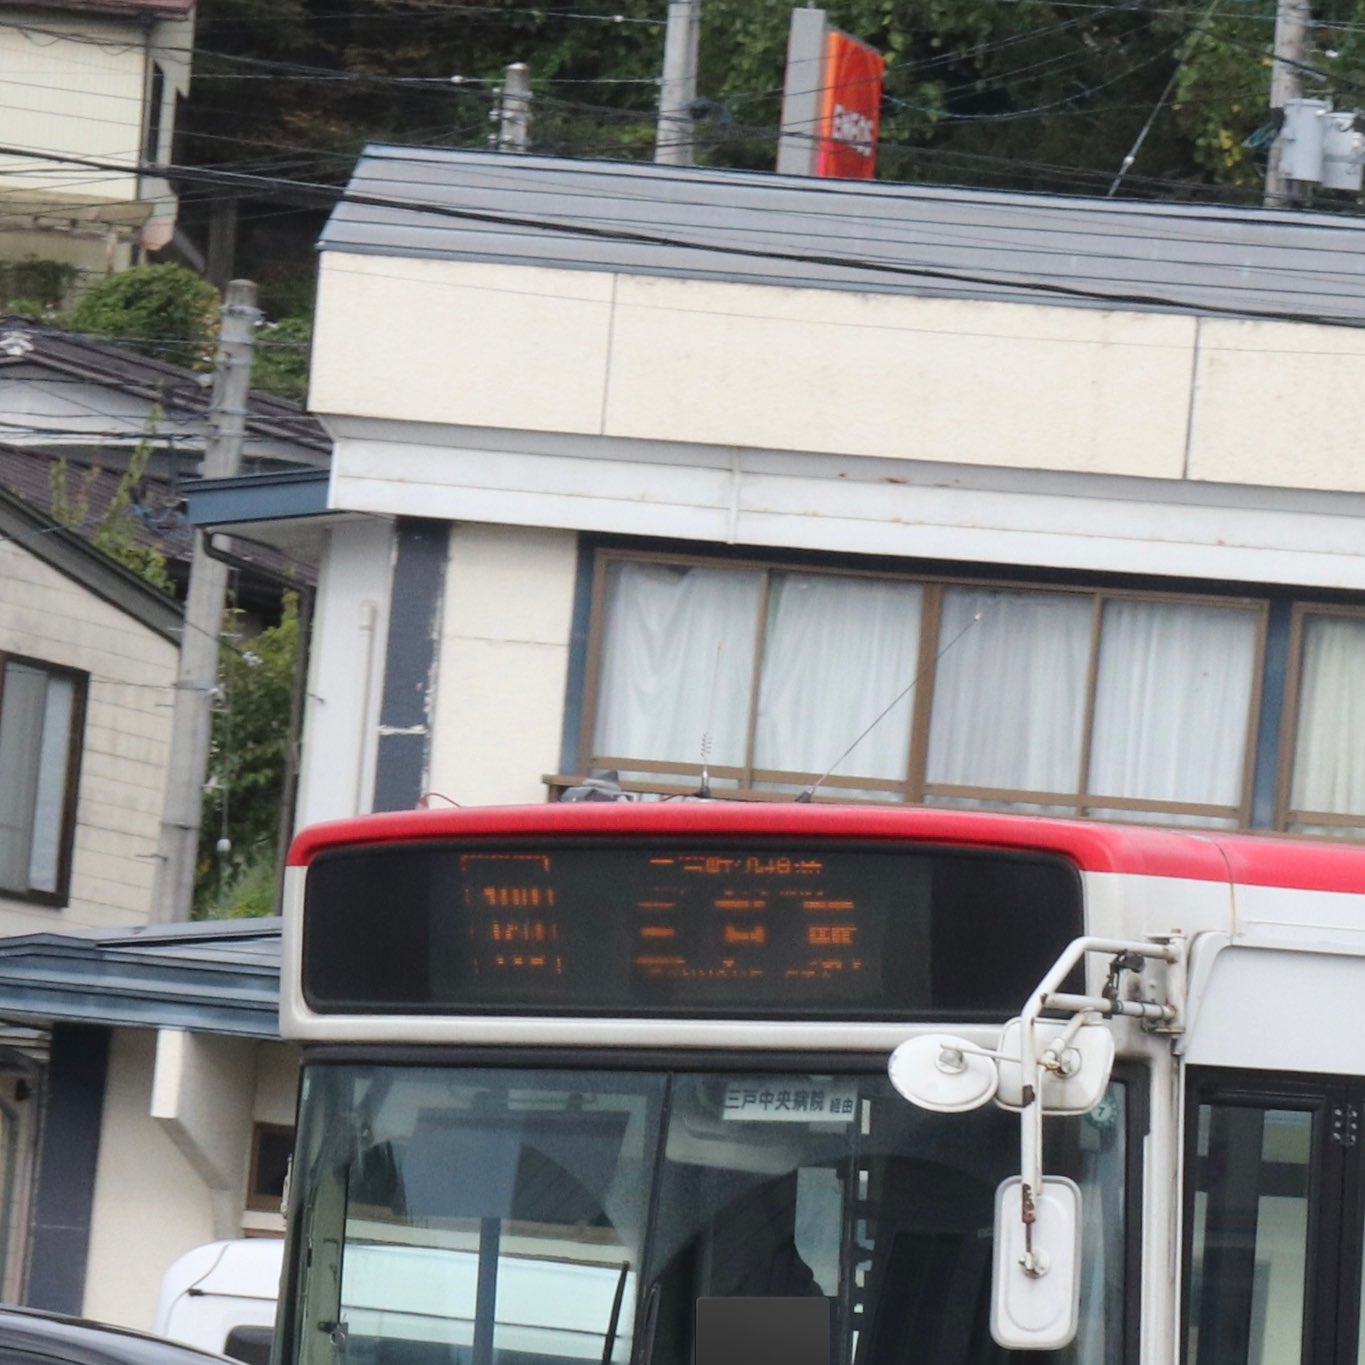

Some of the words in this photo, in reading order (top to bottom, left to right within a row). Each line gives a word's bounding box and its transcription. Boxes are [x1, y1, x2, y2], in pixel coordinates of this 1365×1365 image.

[725, 1089, 825, 1112] 三戸中央病院
[829, 1098, 854, 1114] 経由
